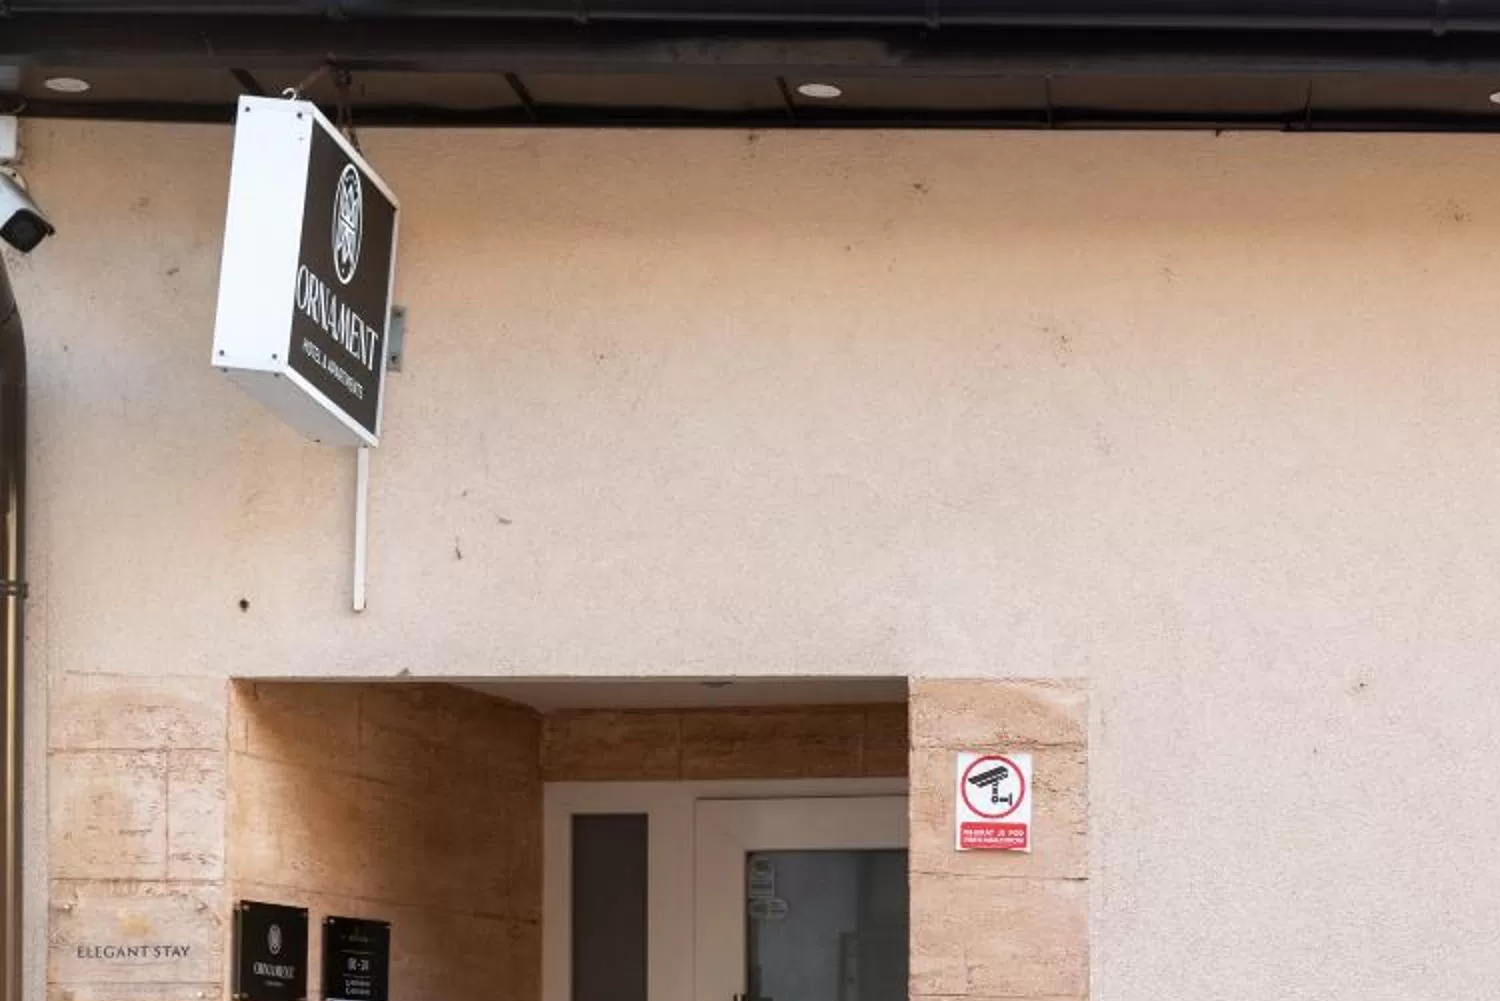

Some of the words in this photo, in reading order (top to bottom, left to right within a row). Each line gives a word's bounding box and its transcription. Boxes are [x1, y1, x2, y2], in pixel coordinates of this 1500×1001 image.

[295, 264, 380, 372] ORNAMENT
[76, 943, 151, 960] ELEGANT
[153, 943, 192, 960] STAY
